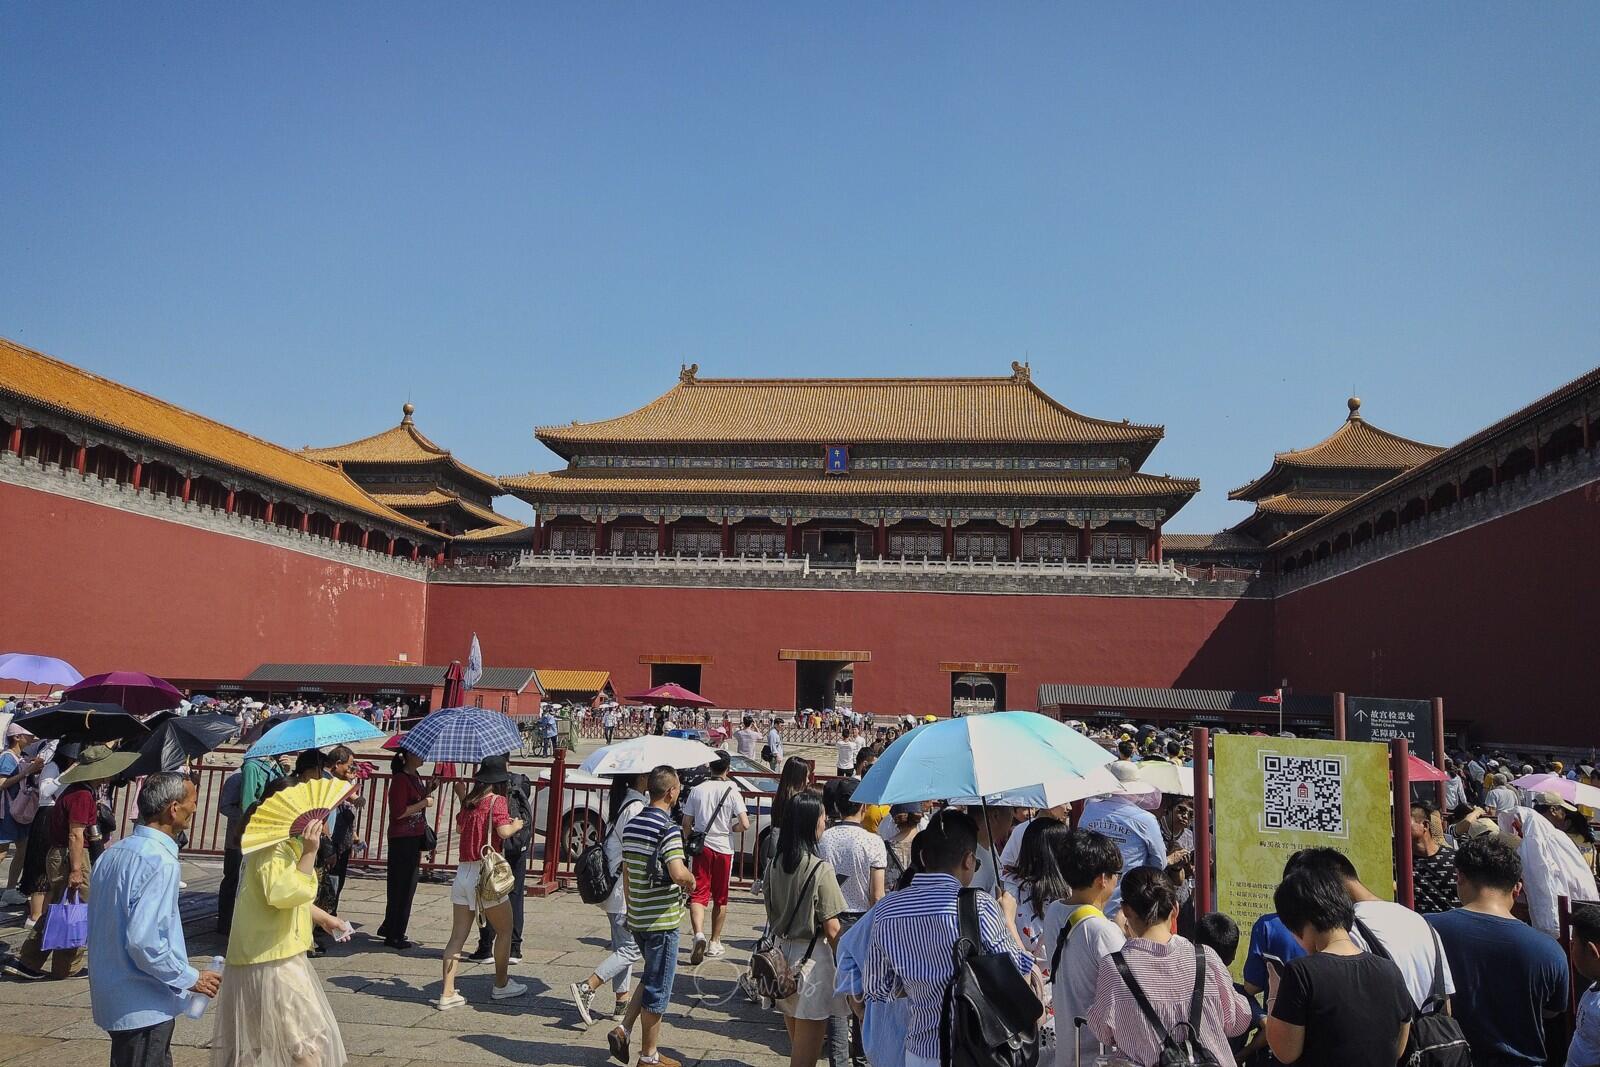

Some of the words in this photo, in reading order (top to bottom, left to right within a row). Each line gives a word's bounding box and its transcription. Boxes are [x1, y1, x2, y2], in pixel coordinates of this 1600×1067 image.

[1371, 710, 1415, 720] 故宫检票处
[1371, 729, 1415, 738] 无障碍入口
